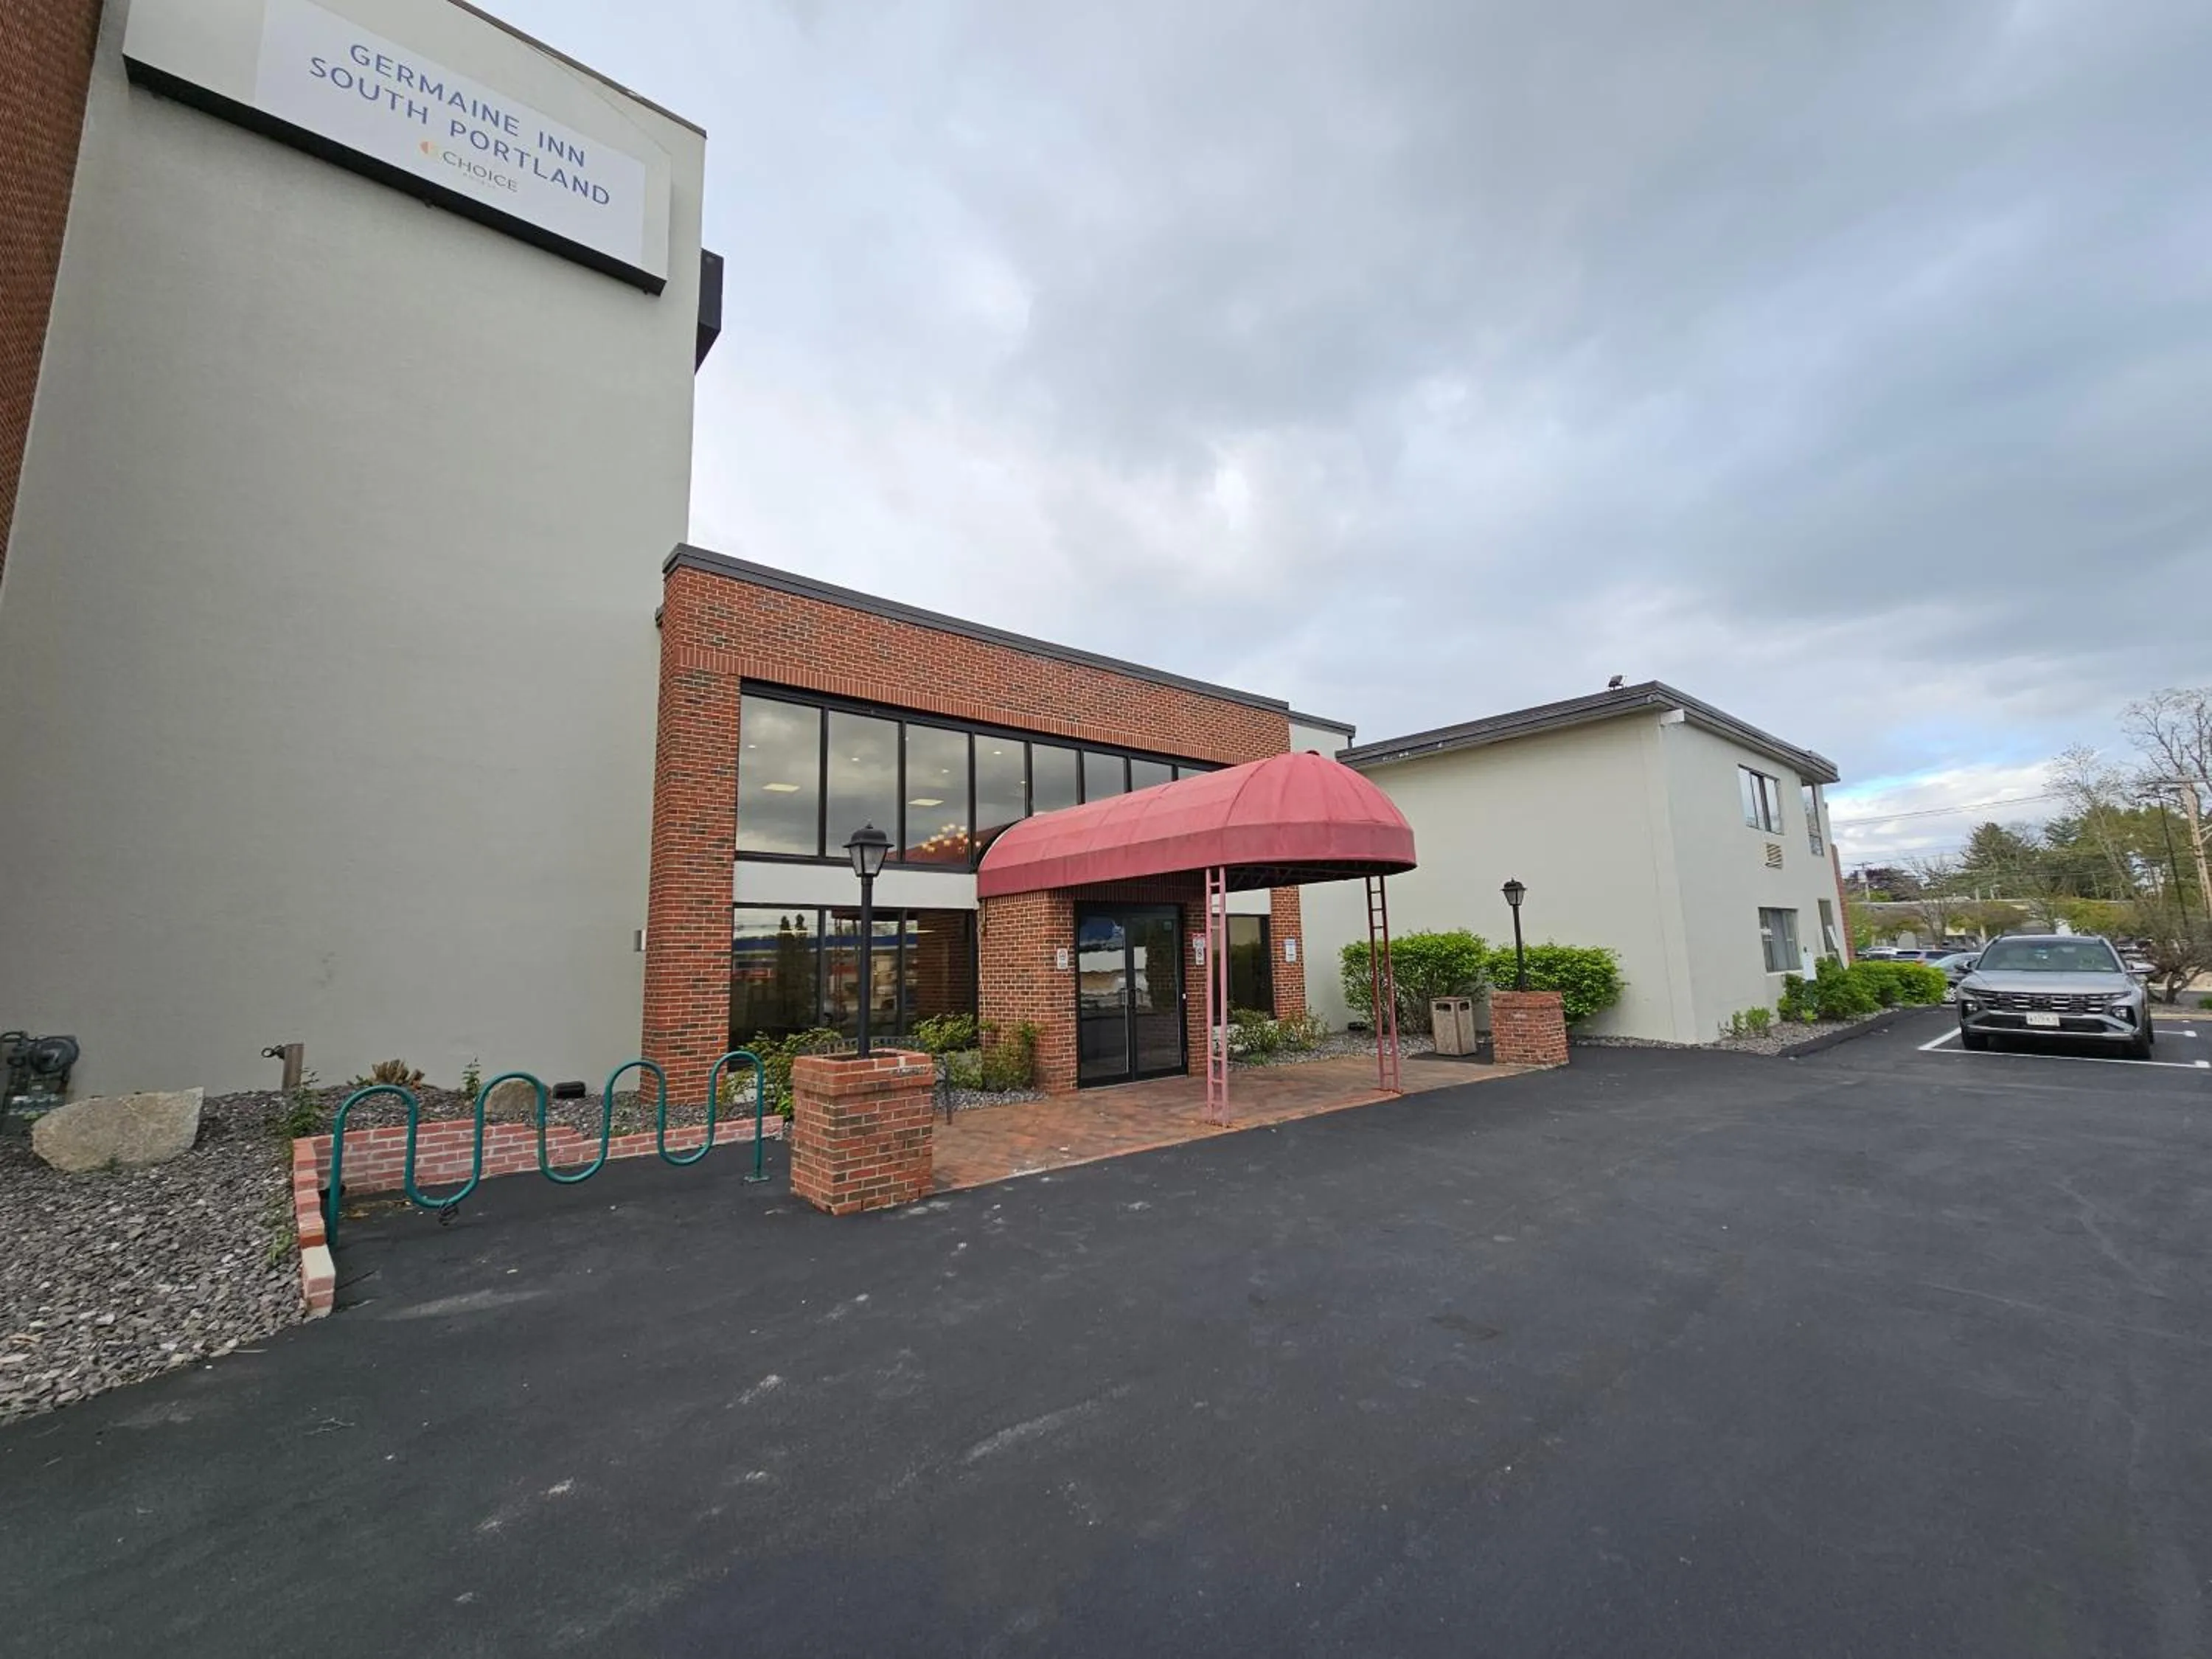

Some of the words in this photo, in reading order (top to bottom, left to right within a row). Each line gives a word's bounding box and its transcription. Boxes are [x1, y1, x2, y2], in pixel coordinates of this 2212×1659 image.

[309, 57, 428, 125] SOUTH
[450, 119, 610, 205] PORTLAND
[349, 44, 519, 136] GERMAINE
[538, 130, 585, 167] INN
[443, 151, 518, 192] CHOICE
